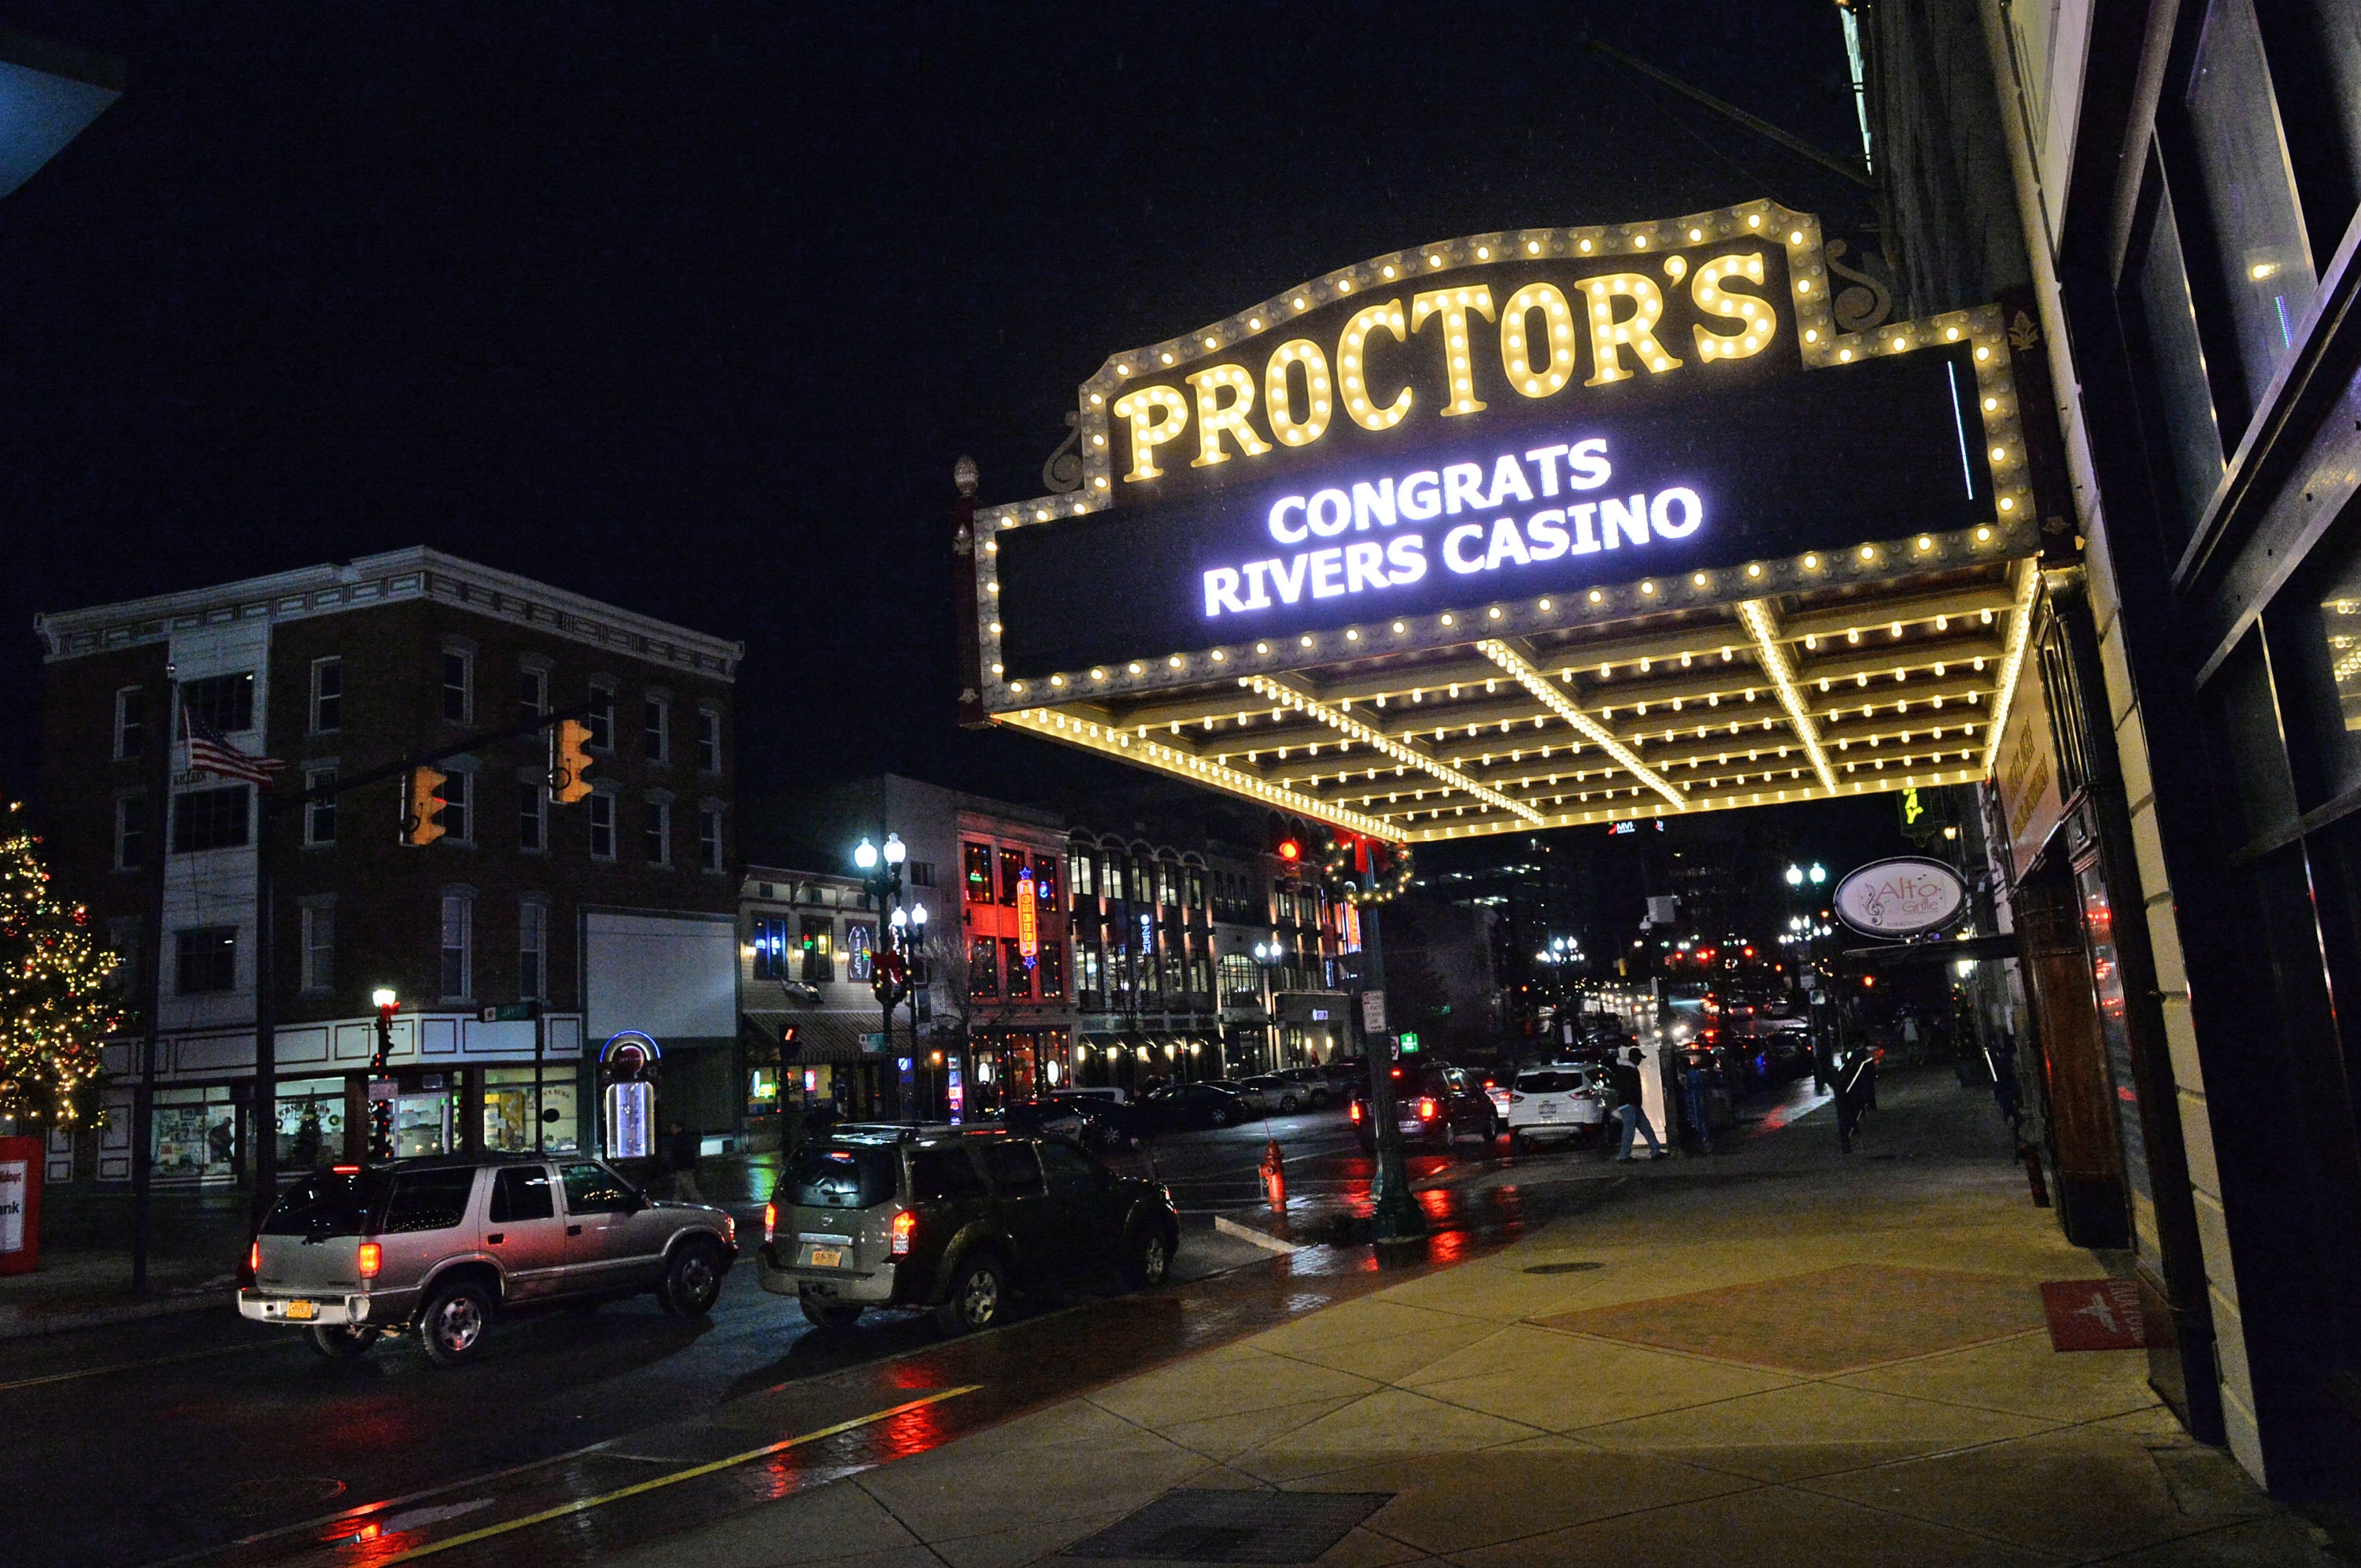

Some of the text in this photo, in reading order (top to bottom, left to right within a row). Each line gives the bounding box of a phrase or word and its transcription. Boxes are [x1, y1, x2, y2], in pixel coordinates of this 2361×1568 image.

[1114, 252, 1777, 483] PROCTOR'S
[1267, 437, 1613, 544] CONGRATS
[1203, 485, 1704, 618] RIVERS CASINO
[1903, 788, 1923, 825] AY
[1875, 876, 1938, 902] Alto
[1901, 897, 1939, 913] Grille
[1141, 925, 1151, 954] ZEN
